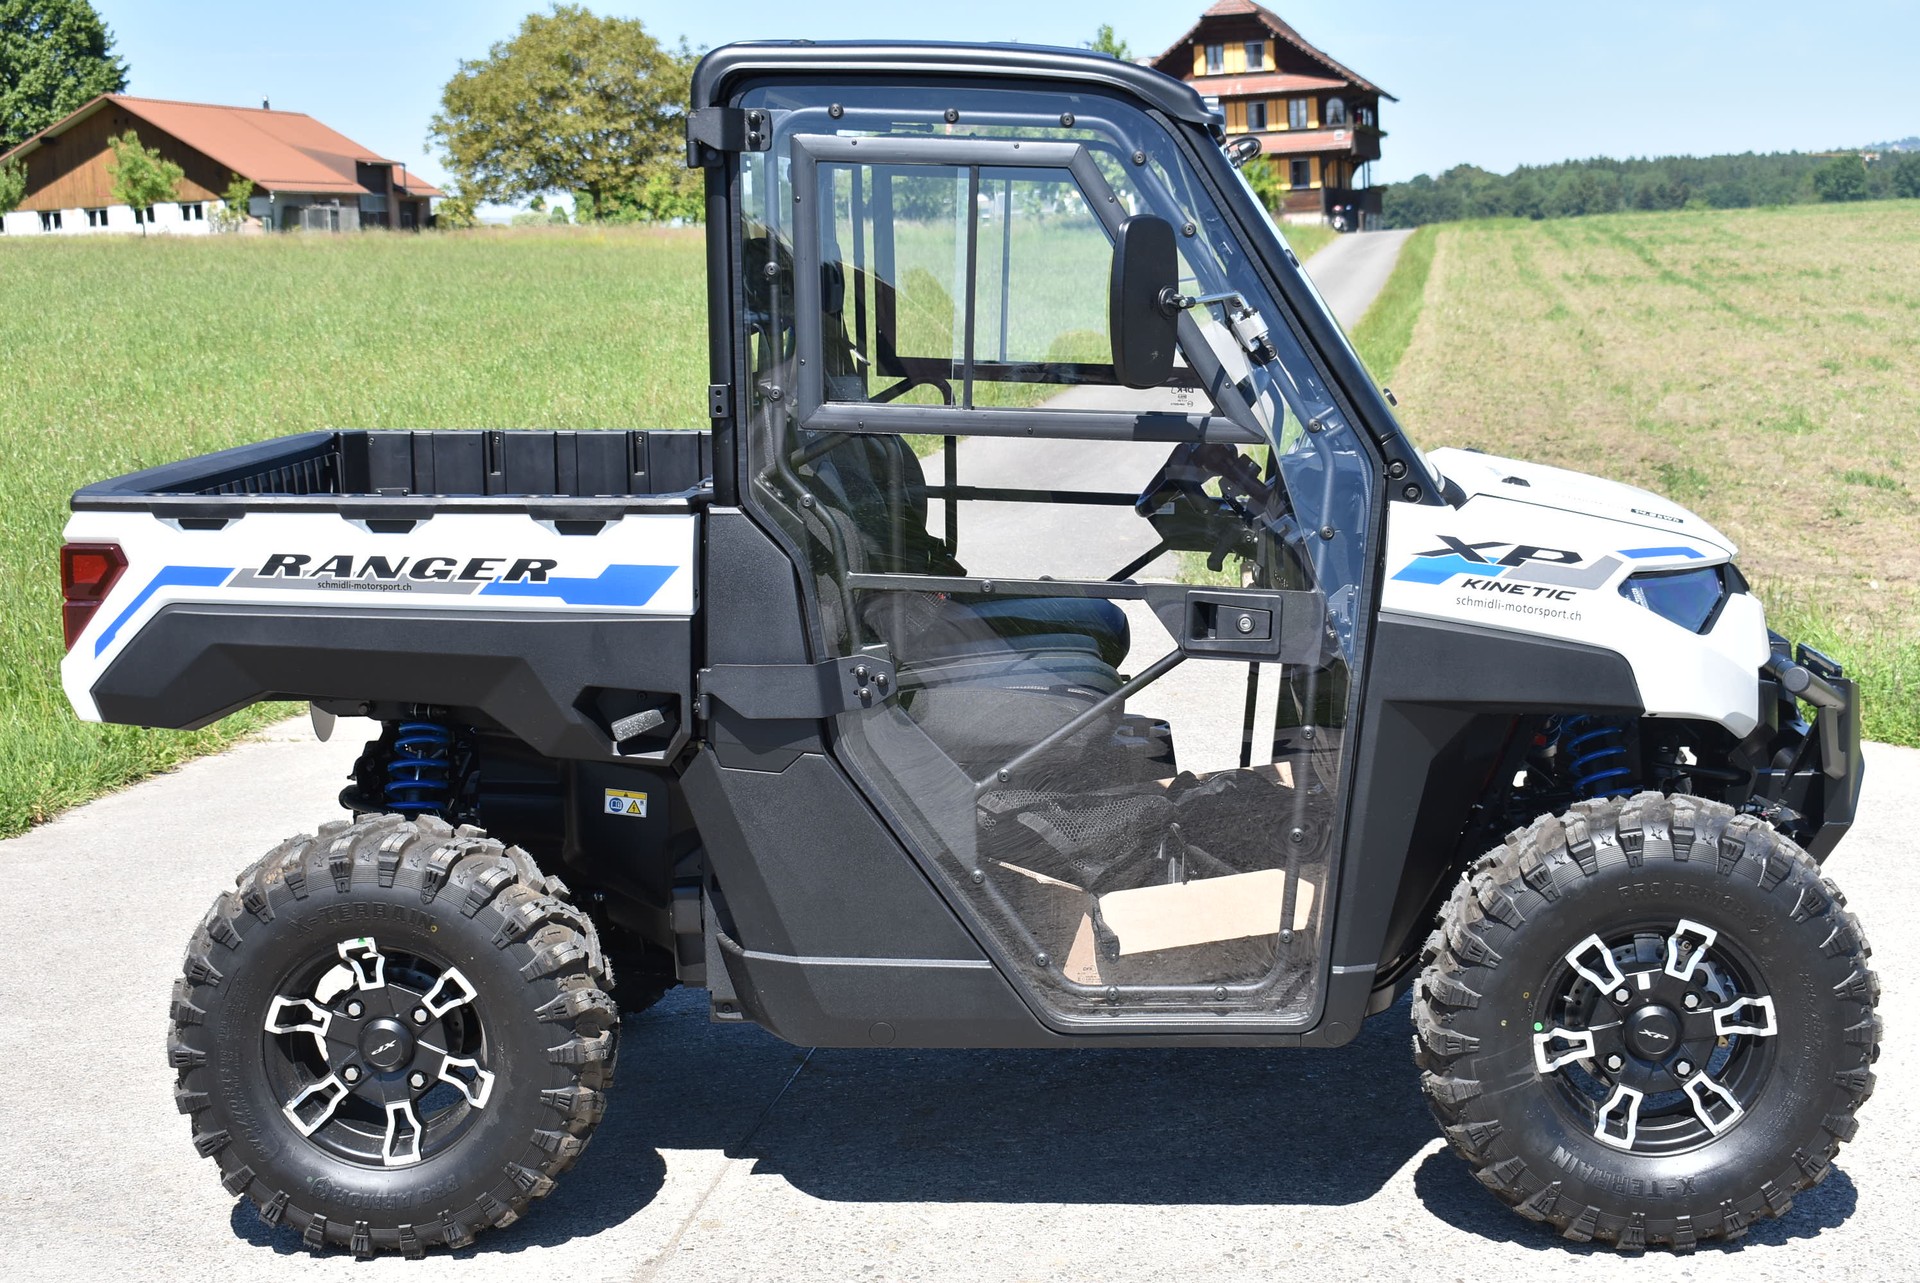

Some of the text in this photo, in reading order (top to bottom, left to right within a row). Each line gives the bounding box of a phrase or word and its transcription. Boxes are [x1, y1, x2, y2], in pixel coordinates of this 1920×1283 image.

[1411, 534, 1583, 567] XP
[258, 553, 558, 581] RANGER
[317, 580, 412, 592] schmidli-motorsport.ch
[1461, 578, 1577, 601] KINETIC
[1456, 596, 1582, 621] schmidli-motorsport.ch
[286, 901, 438, 938] X-TERRAIN
[1549, 1144, 1699, 1199] X-TERRAIN
